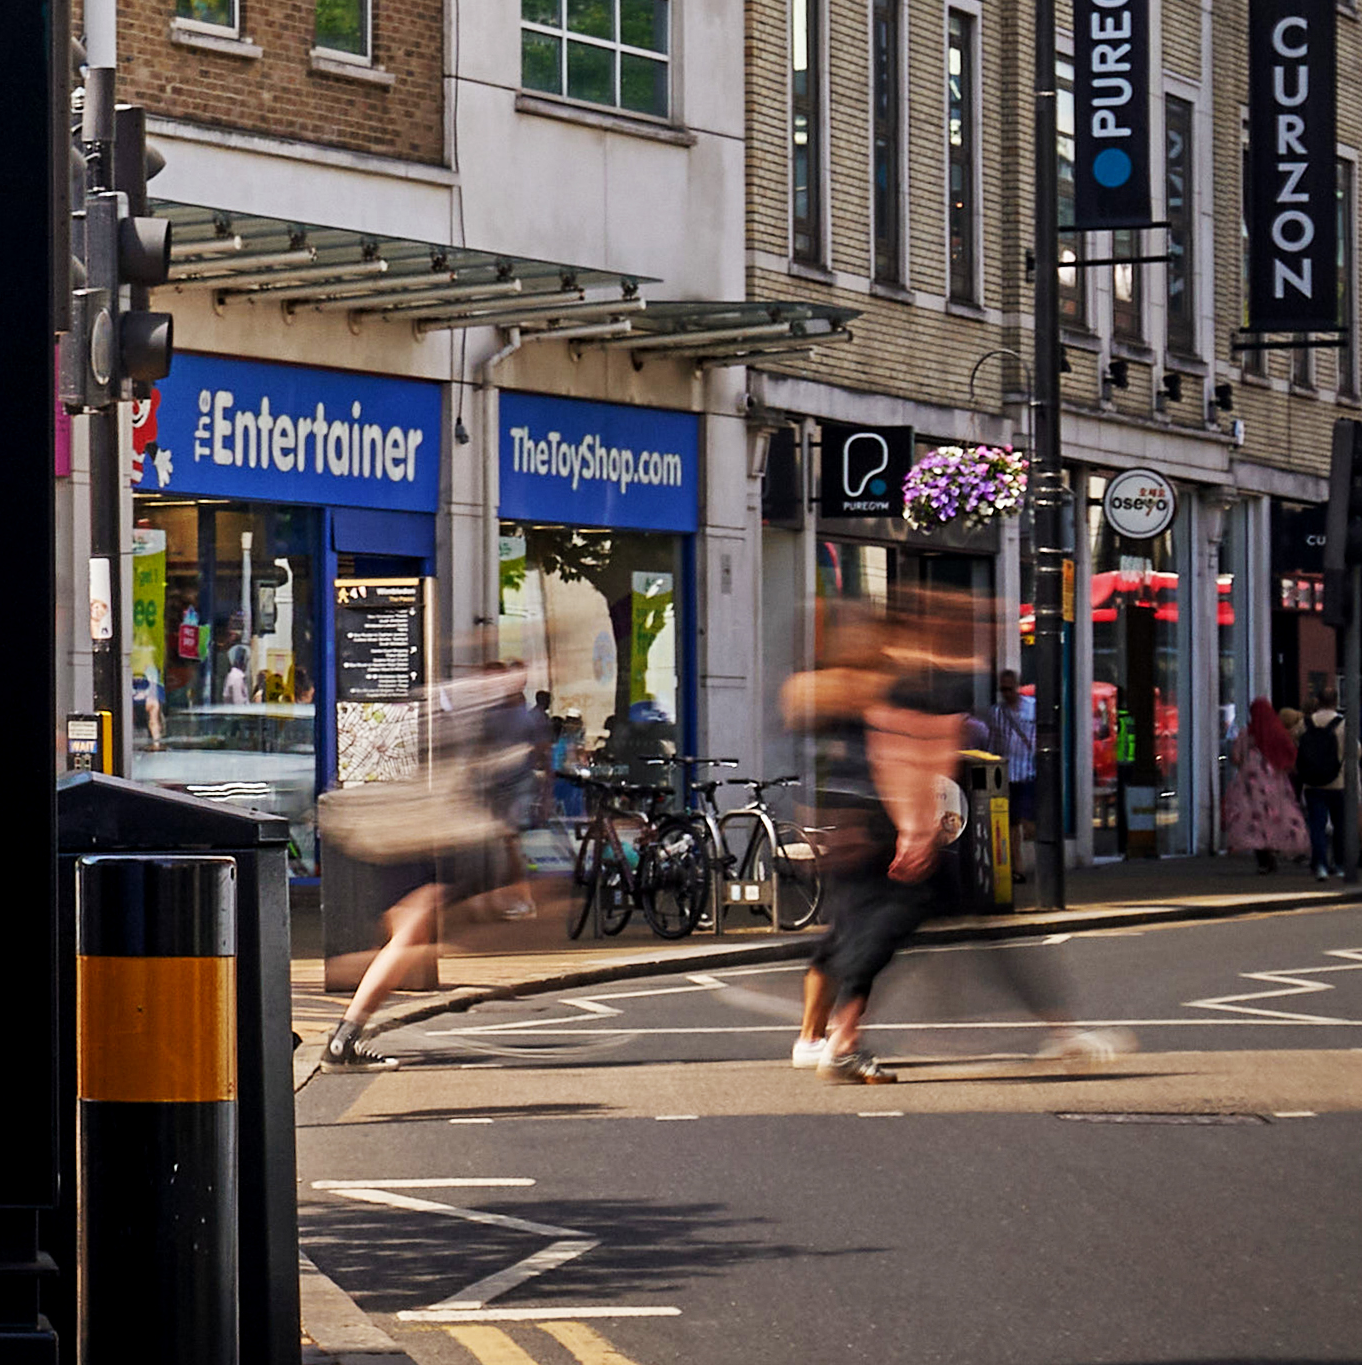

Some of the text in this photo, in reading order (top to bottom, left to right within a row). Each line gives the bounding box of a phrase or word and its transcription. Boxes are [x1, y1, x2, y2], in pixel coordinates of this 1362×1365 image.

[1272, 16, 1314, 299] CURZON
[194, 389, 423, 482] The Entertainer
[510, 426, 682, 494] TheToyShop.com
[843, 501, 889, 511] PUREGYM
[1112, 497, 1167, 517] oseyo
